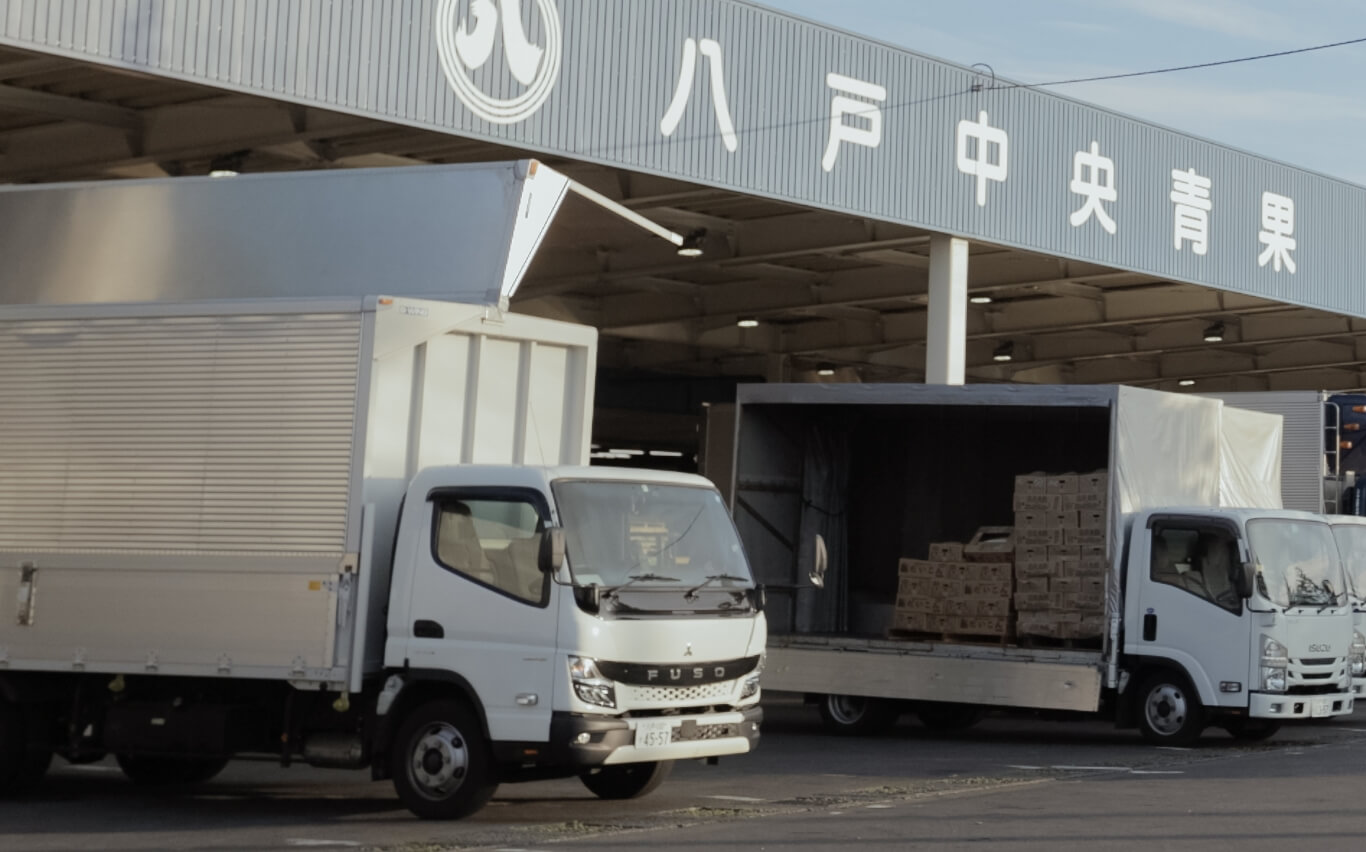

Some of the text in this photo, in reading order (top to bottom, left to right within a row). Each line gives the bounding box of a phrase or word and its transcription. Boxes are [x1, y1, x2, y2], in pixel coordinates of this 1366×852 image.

[661, 38, 1297, 275] 八戸中央青果
[647, 667, 725, 680] FUSO
